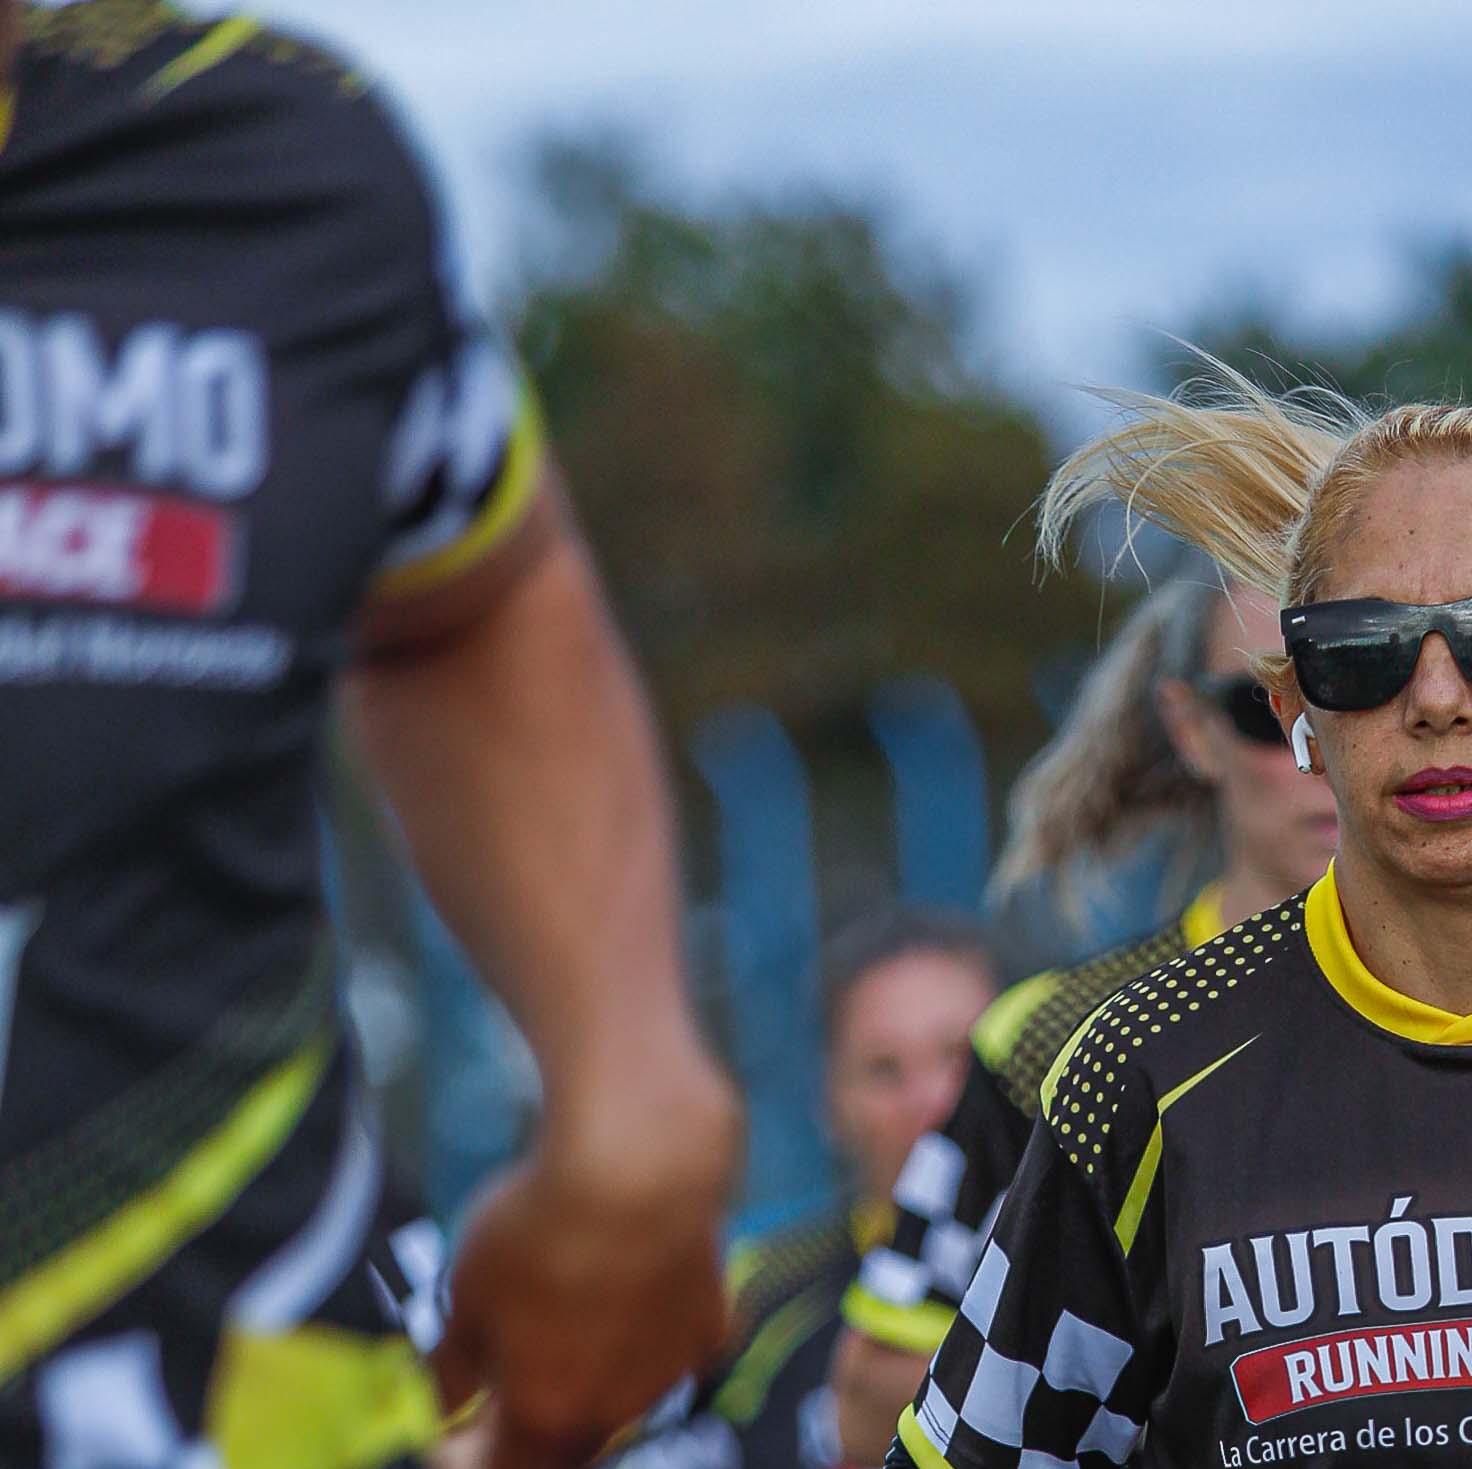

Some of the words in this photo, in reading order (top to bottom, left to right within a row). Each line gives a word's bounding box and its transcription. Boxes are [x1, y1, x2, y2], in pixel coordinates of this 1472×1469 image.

[1219, 1440, 1242, 1468] La
[1246, 1429, 1346, 1464] Carrera
[1356, 1419, 1395, 1448] de
[1405, 1417, 1449, 1447] los
